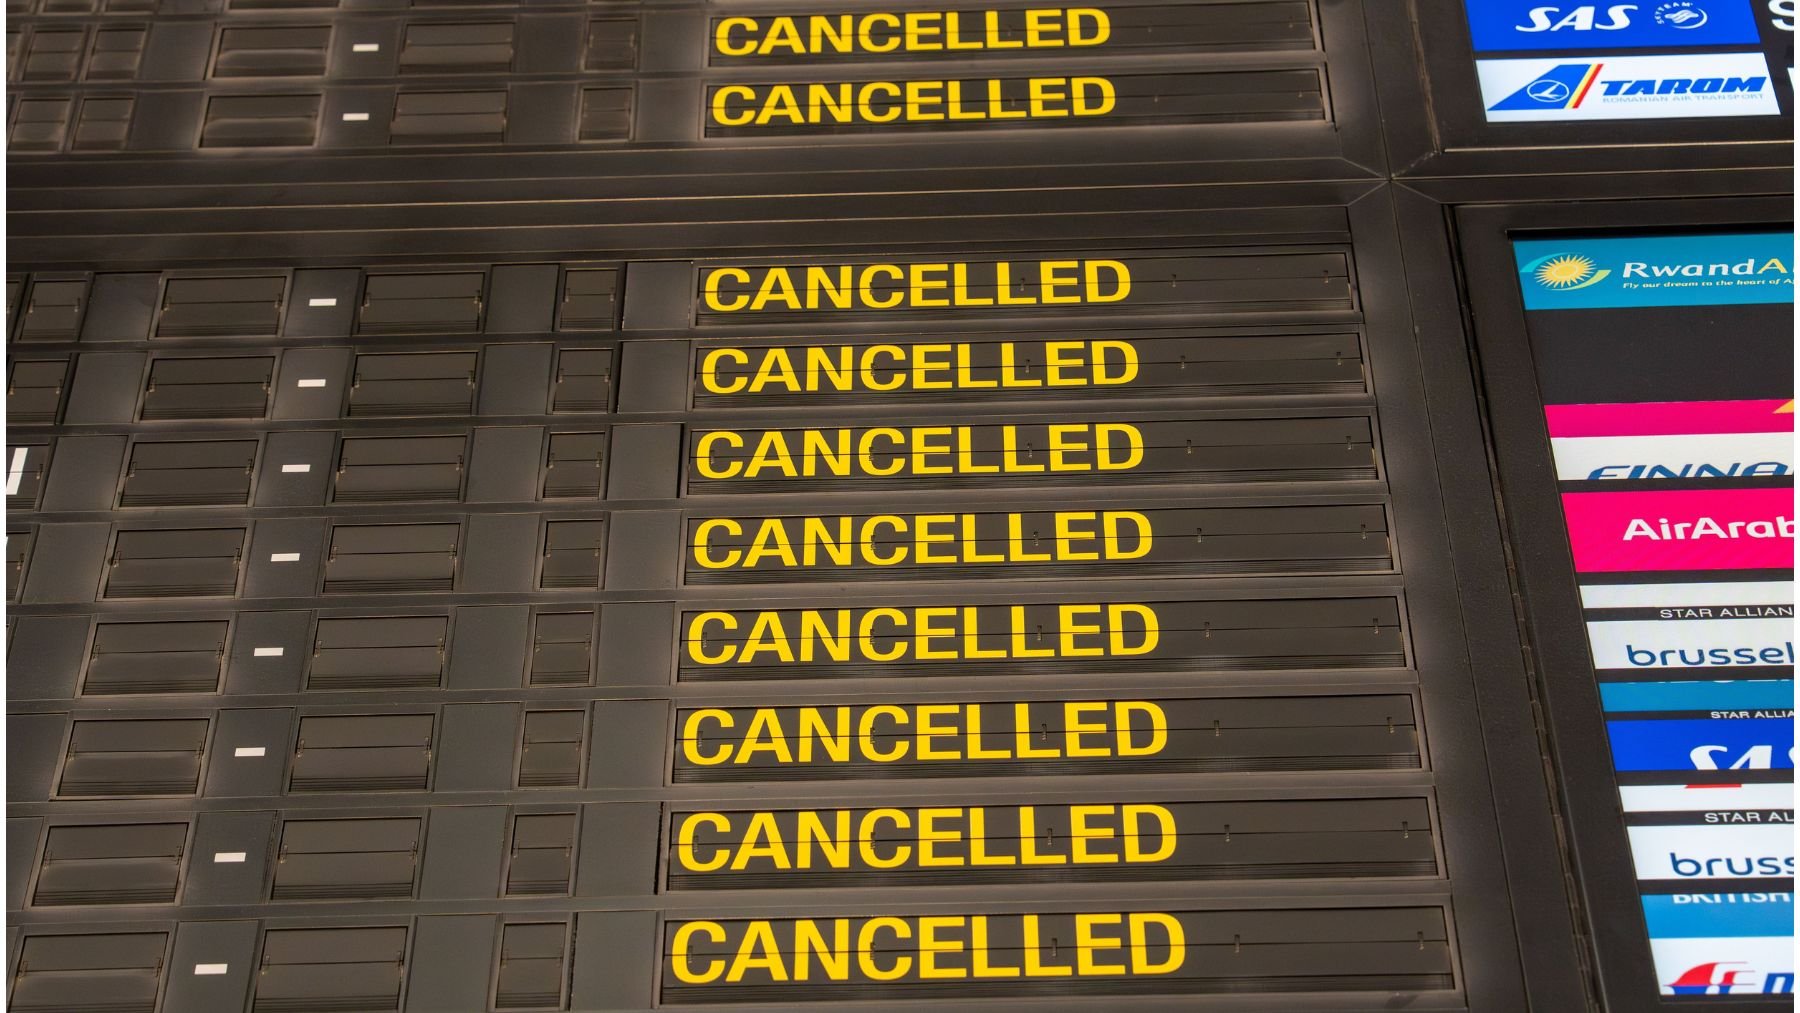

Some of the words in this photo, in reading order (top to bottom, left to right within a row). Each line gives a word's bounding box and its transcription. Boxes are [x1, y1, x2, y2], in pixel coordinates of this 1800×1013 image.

[716, 9, 1110, 56] CANCELLED
[1515, 4, 1638, 32] SAS
[712, 77, 1115, 125] CANCELLED
[1601, 76, 1767, 96] TAROM
[705, 260, 1131, 311] CANCELLED
[702, 341, 1138, 393] CANCELLED
[696, 424, 1143, 479] CANCELLED
[694, 511, 1152, 568] CANCELLED
[688, 604, 1159, 664] CANCELLED
[1660, 608, 1713, 618] STAR
[683, 701, 1167, 765] CANCELLED
[1710, 711, 1750, 719] STAR
[678, 805, 1176, 872] CANCELLED
[1704, 812, 1761, 823] STAR
[672, 913, 1185, 984] CANCELLED
